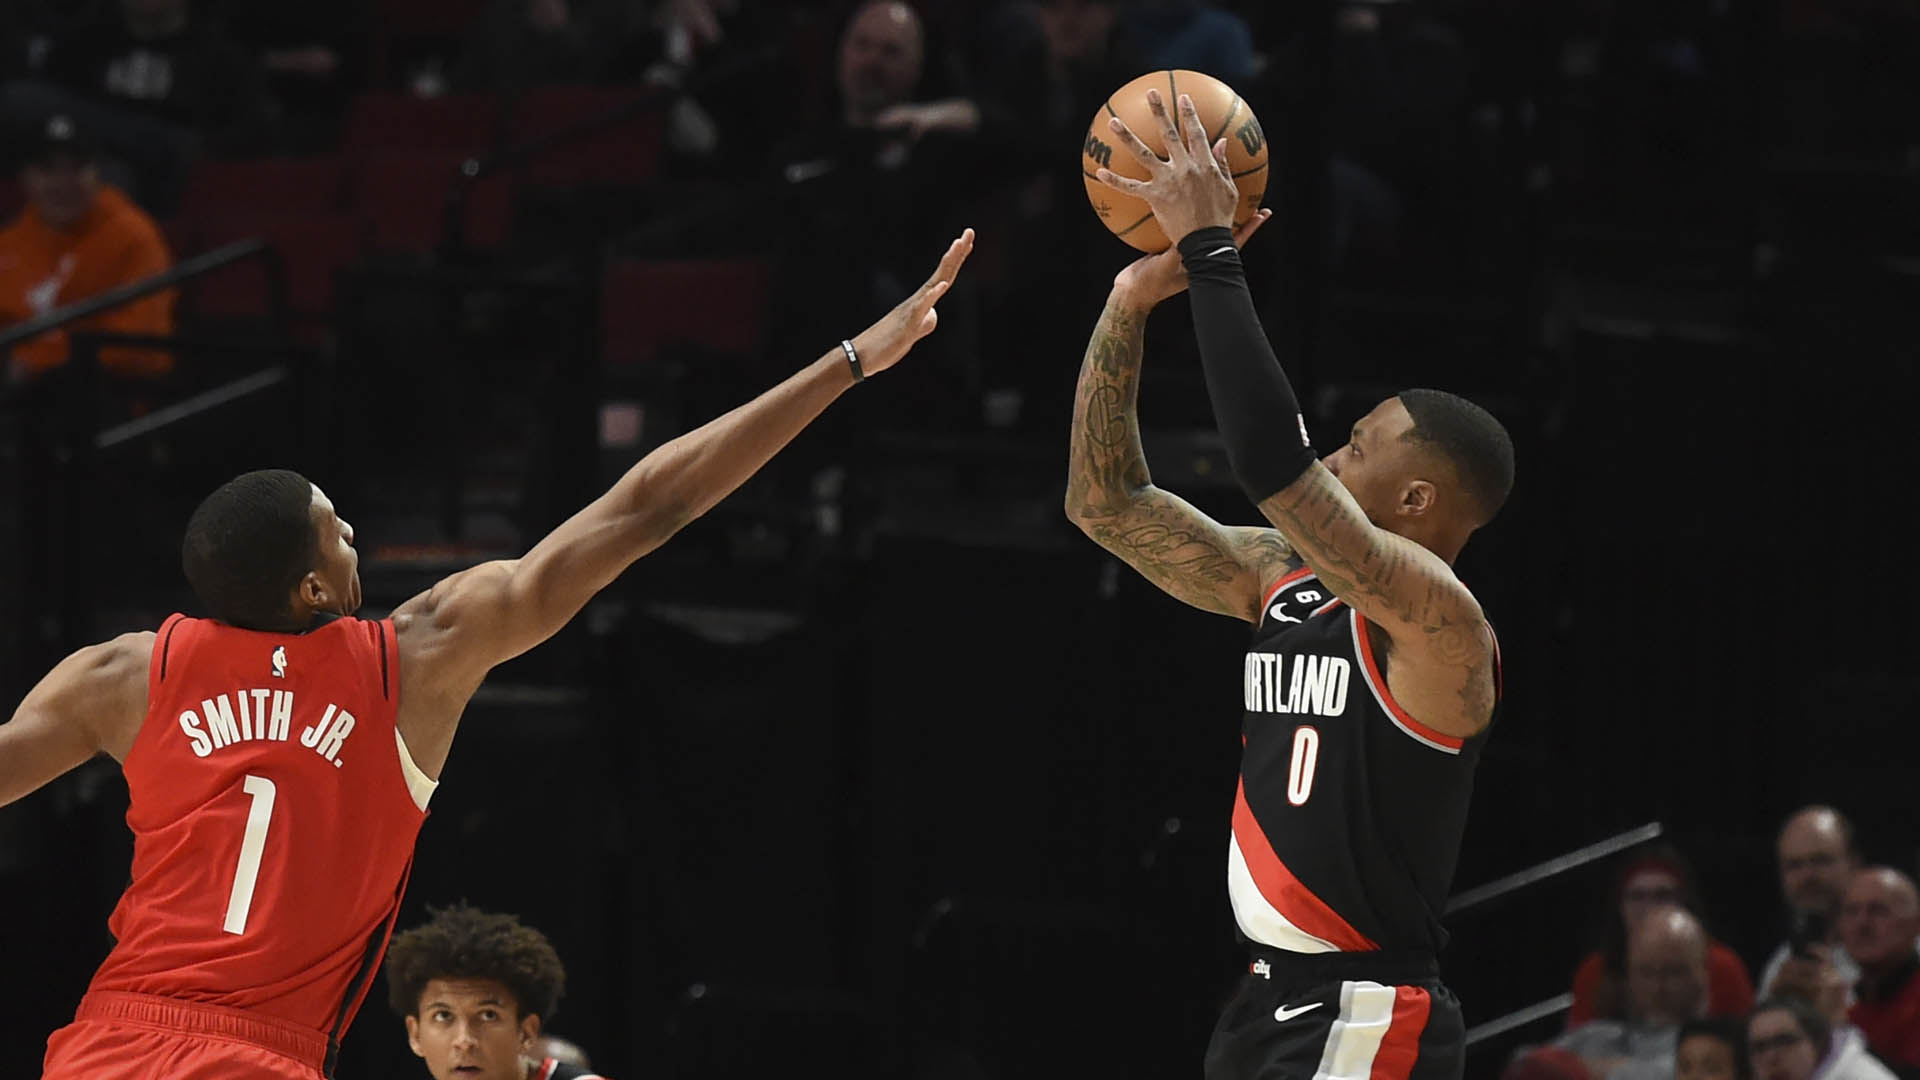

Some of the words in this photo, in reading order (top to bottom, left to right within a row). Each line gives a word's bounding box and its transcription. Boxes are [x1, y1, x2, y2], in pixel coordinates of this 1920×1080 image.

[1295, 590, 1322, 604] 6
[179, 689, 294, 758] SMITH
[300, 703, 356, 768] JR.
[1287, 725, 1319, 806] 0
[223, 774, 276, 936] 1
